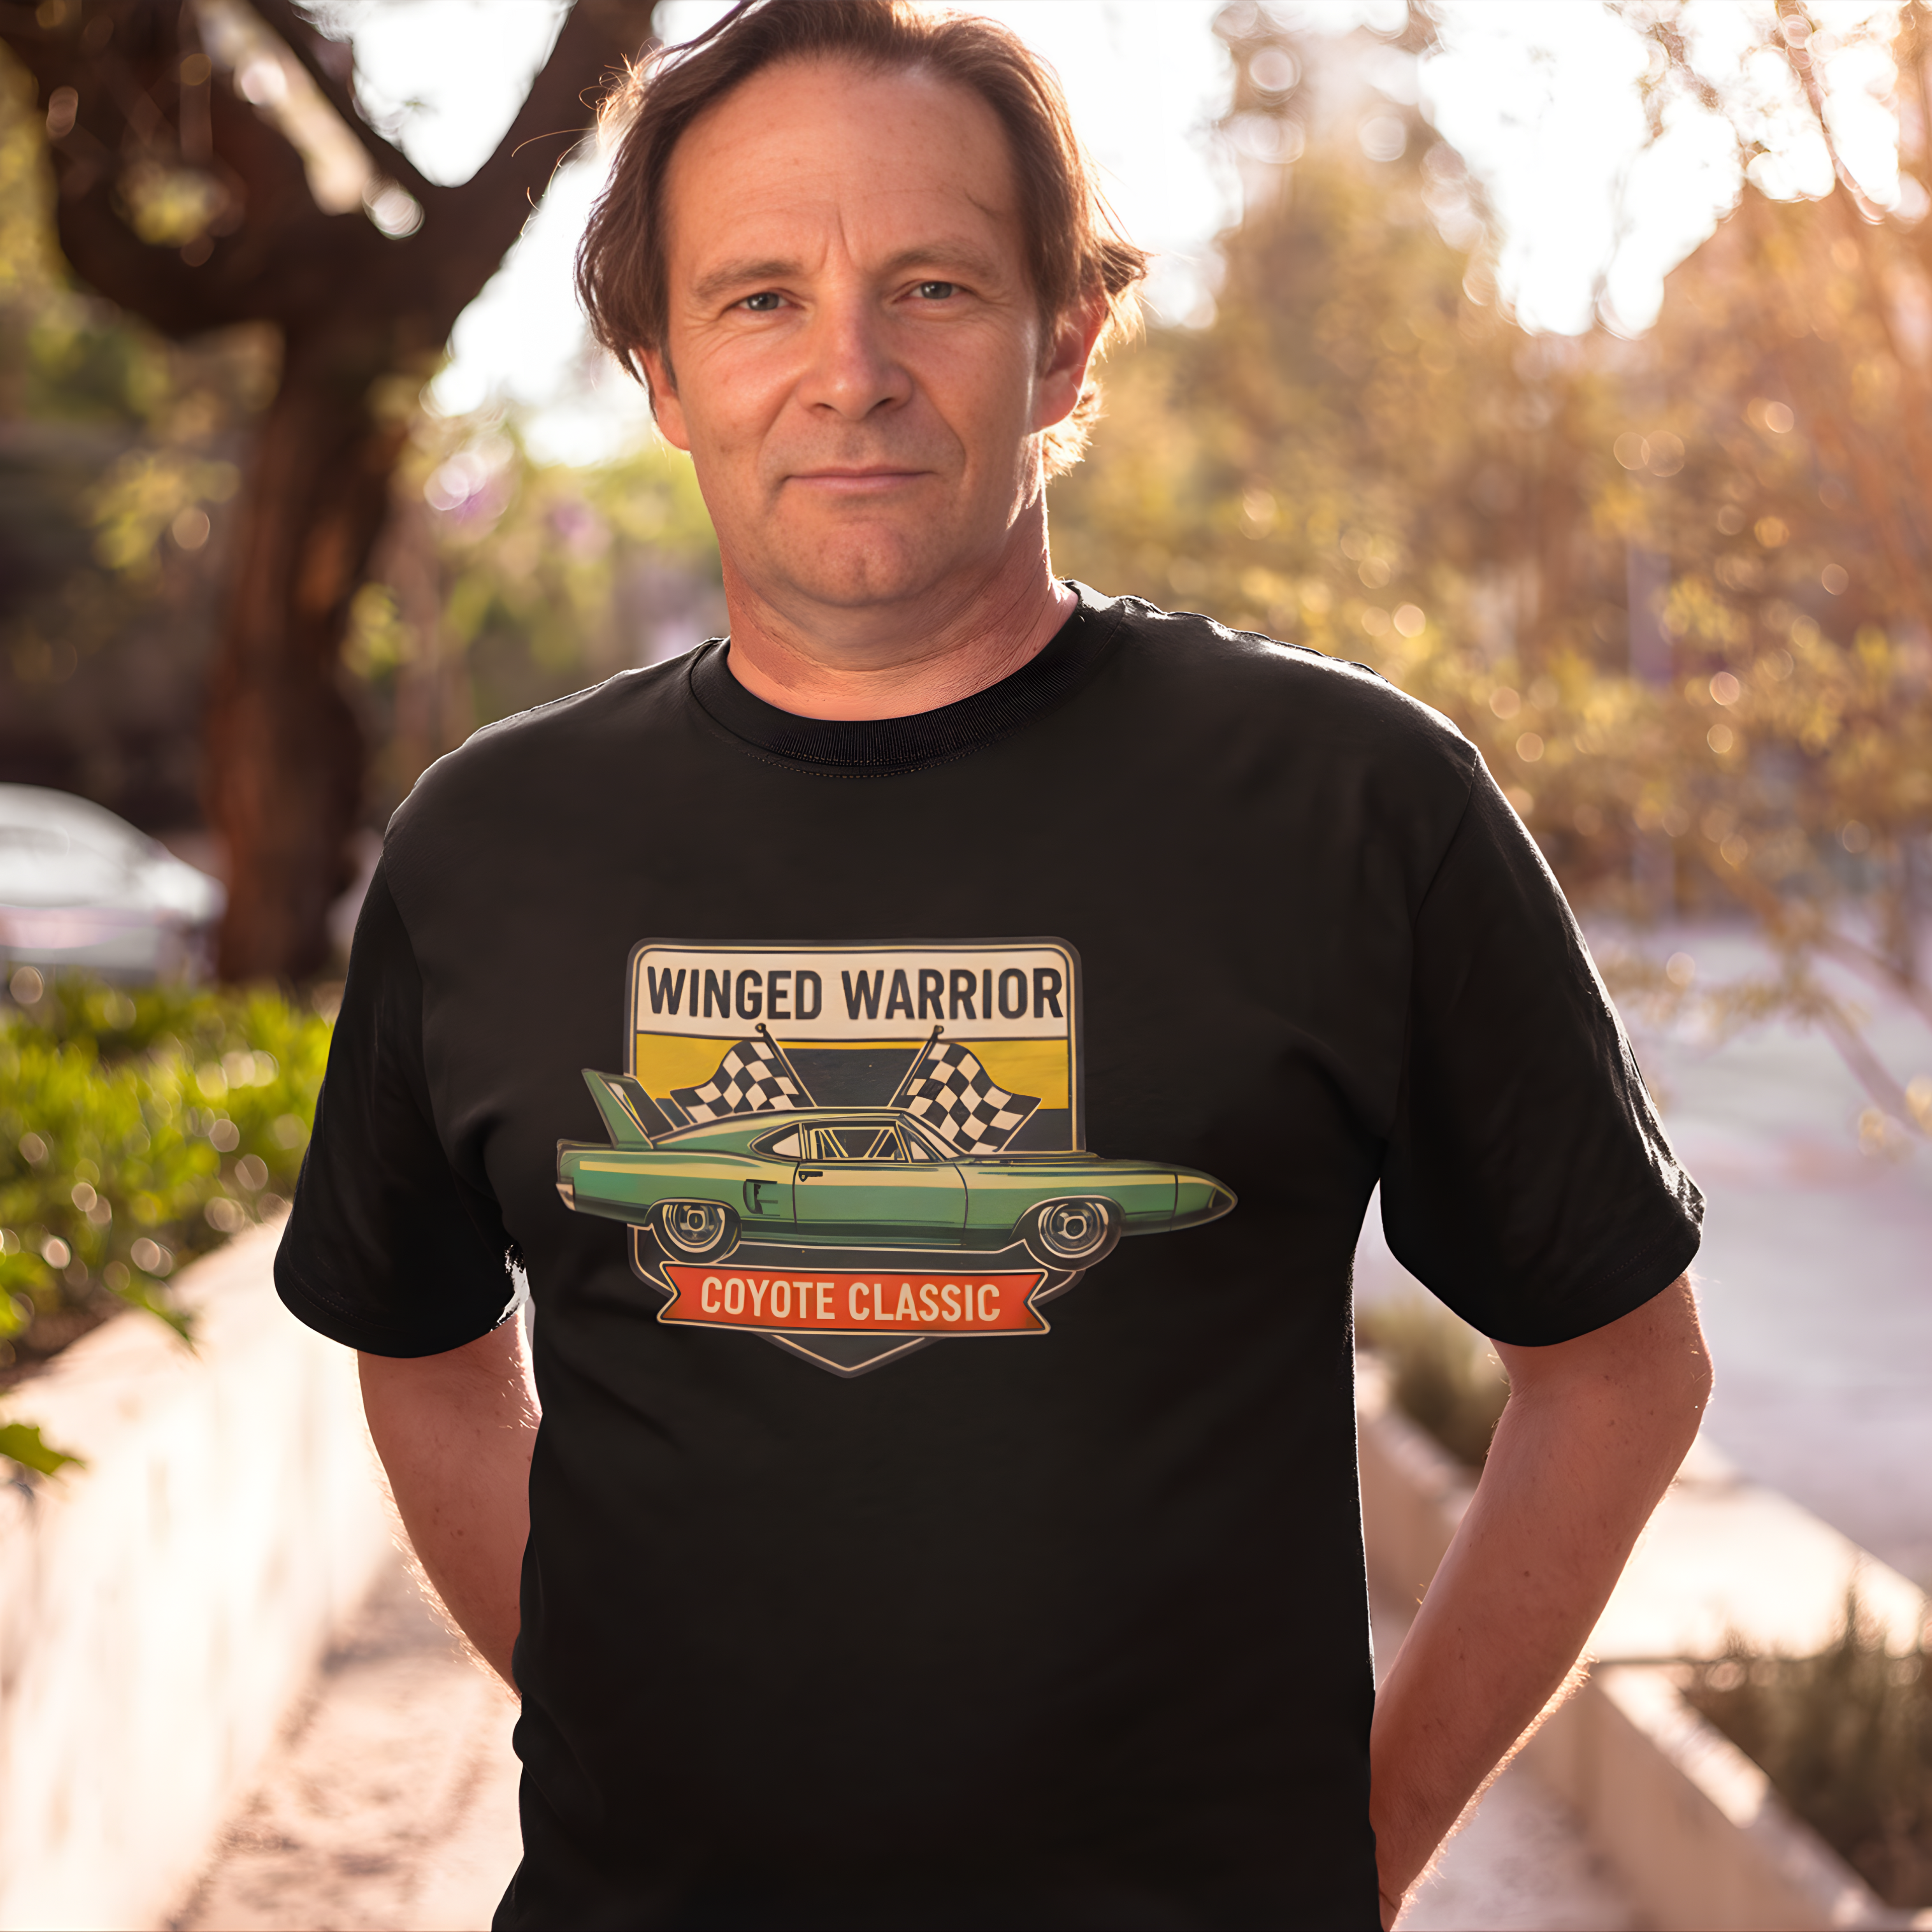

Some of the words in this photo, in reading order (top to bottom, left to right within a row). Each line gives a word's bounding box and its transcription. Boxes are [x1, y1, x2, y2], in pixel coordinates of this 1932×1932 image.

[647, 966, 822, 1020] WINGED
[841, 968, 1064, 1020] WARRIOR
[701, 1276, 835, 1320] COYOTE
[848, 1282, 1001, 1322] CLASSIC
